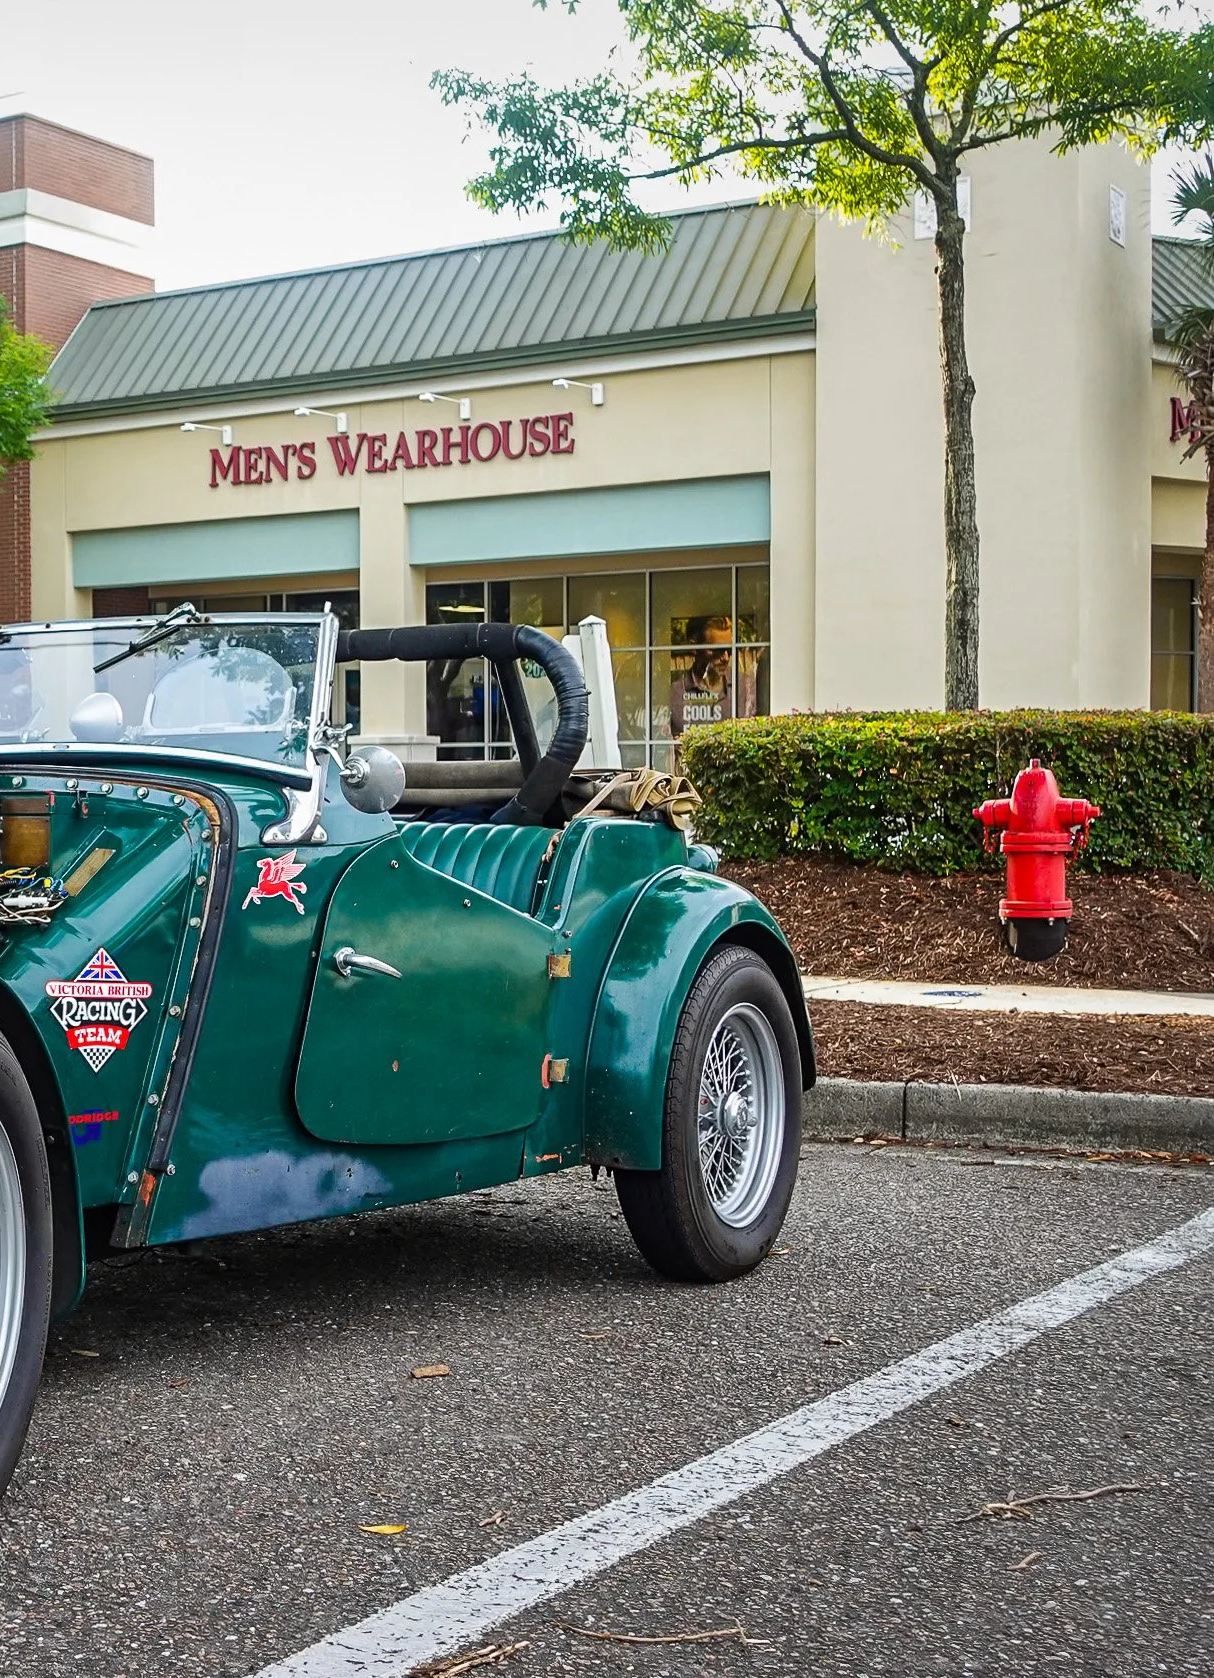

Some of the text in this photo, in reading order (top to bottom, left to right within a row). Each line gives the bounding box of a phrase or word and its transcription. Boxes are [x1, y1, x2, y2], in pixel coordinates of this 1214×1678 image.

[209, 412, 576, 488] MEN'S WEARHOUSE
[682, 704, 723, 721] COOLS
[48, 983, 150, 997] VICTORIA BRITISH
[60, 996, 138, 1027] RACING
[74, 1026, 124, 1045] TEAM
[68, 1110, 119, 1125] ODRIDGE
